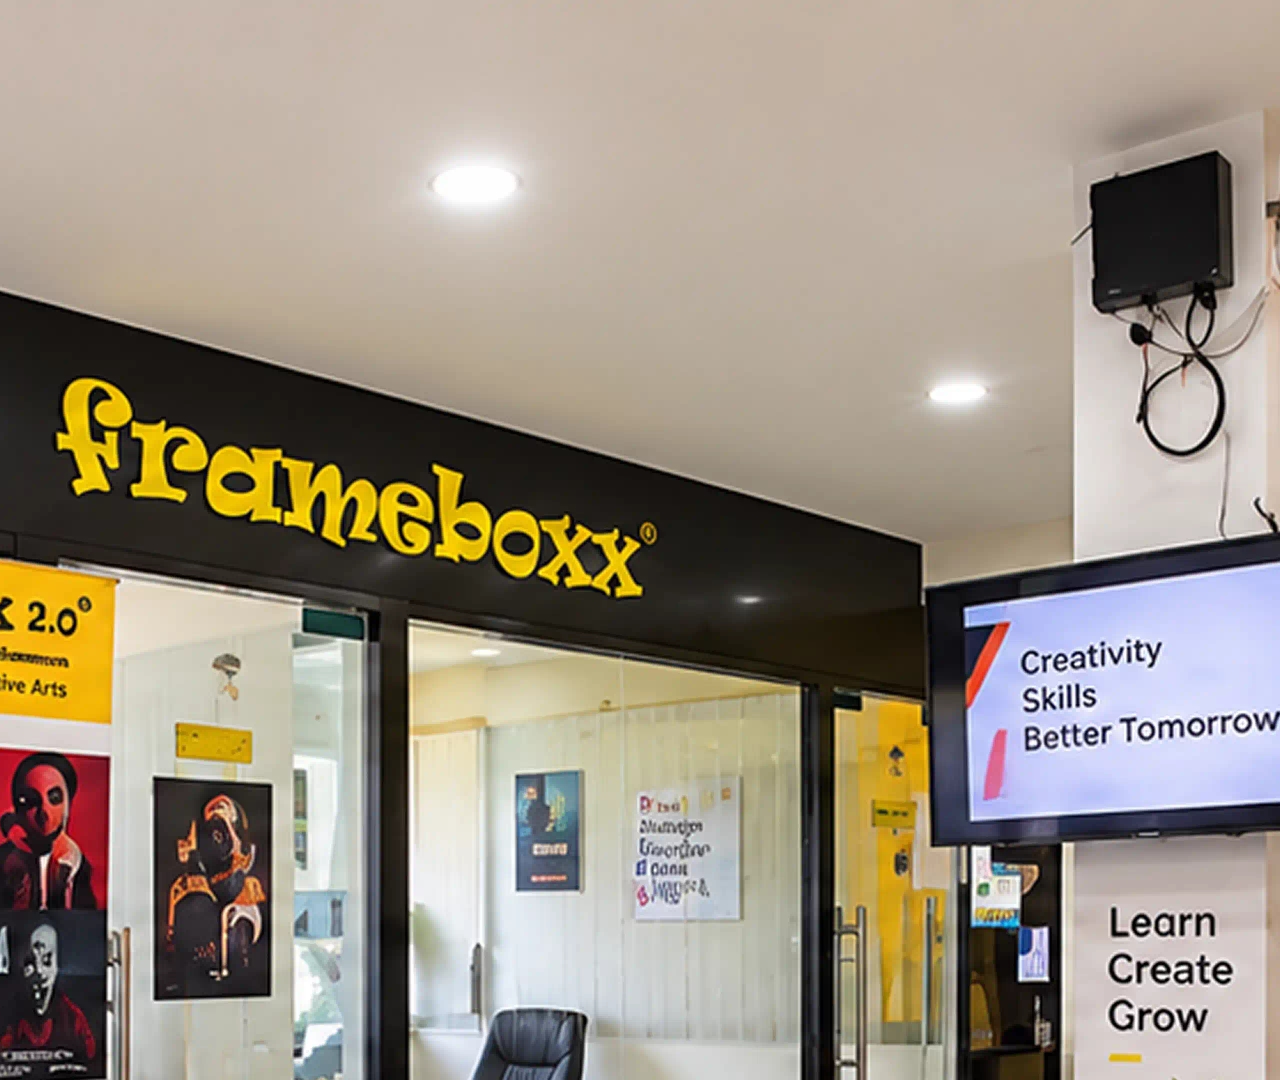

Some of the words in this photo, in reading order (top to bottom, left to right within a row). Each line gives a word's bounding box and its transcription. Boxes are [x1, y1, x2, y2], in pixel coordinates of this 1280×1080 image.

[56, 377, 643, 597] frameboxx
[1021, 637, 1162, 673] Creativity
[31, 679, 68, 698] Arts
[1023, 684, 1097, 713] Skills
[1024, 719, 1112, 752] Better
[1109, 907, 1217, 938] Learn
[1108, 954, 1234, 985] Create
[1108, 1000, 1209, 1033] Grow
